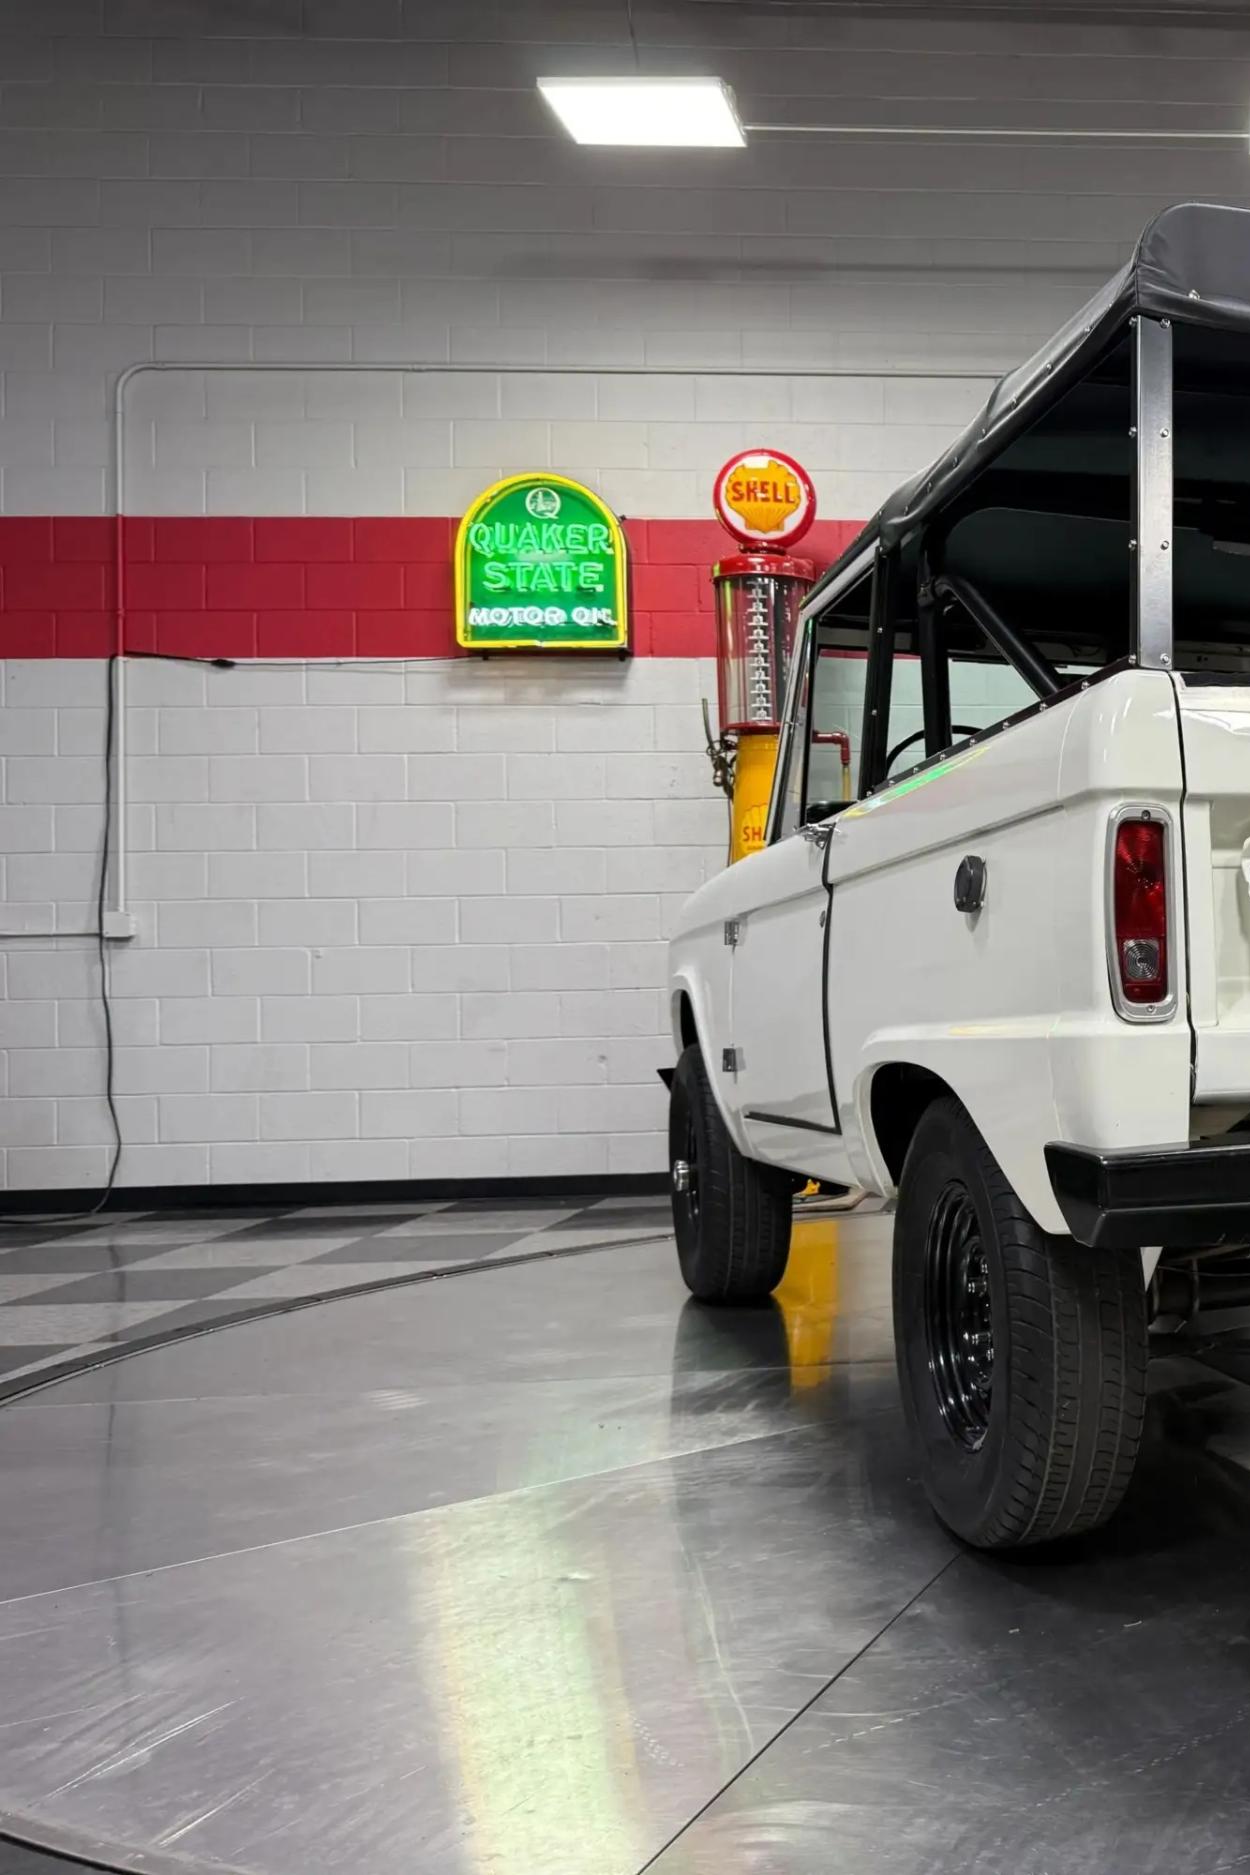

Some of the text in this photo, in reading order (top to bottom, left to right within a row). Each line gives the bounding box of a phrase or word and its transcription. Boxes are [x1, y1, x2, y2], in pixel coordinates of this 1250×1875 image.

[731, 481, 795, 503] SHELL
[468, 521, 614, 558] QUAKER
[482, 561, 604, 592] STATE
[468, 606, 568, 627] MOTOR
